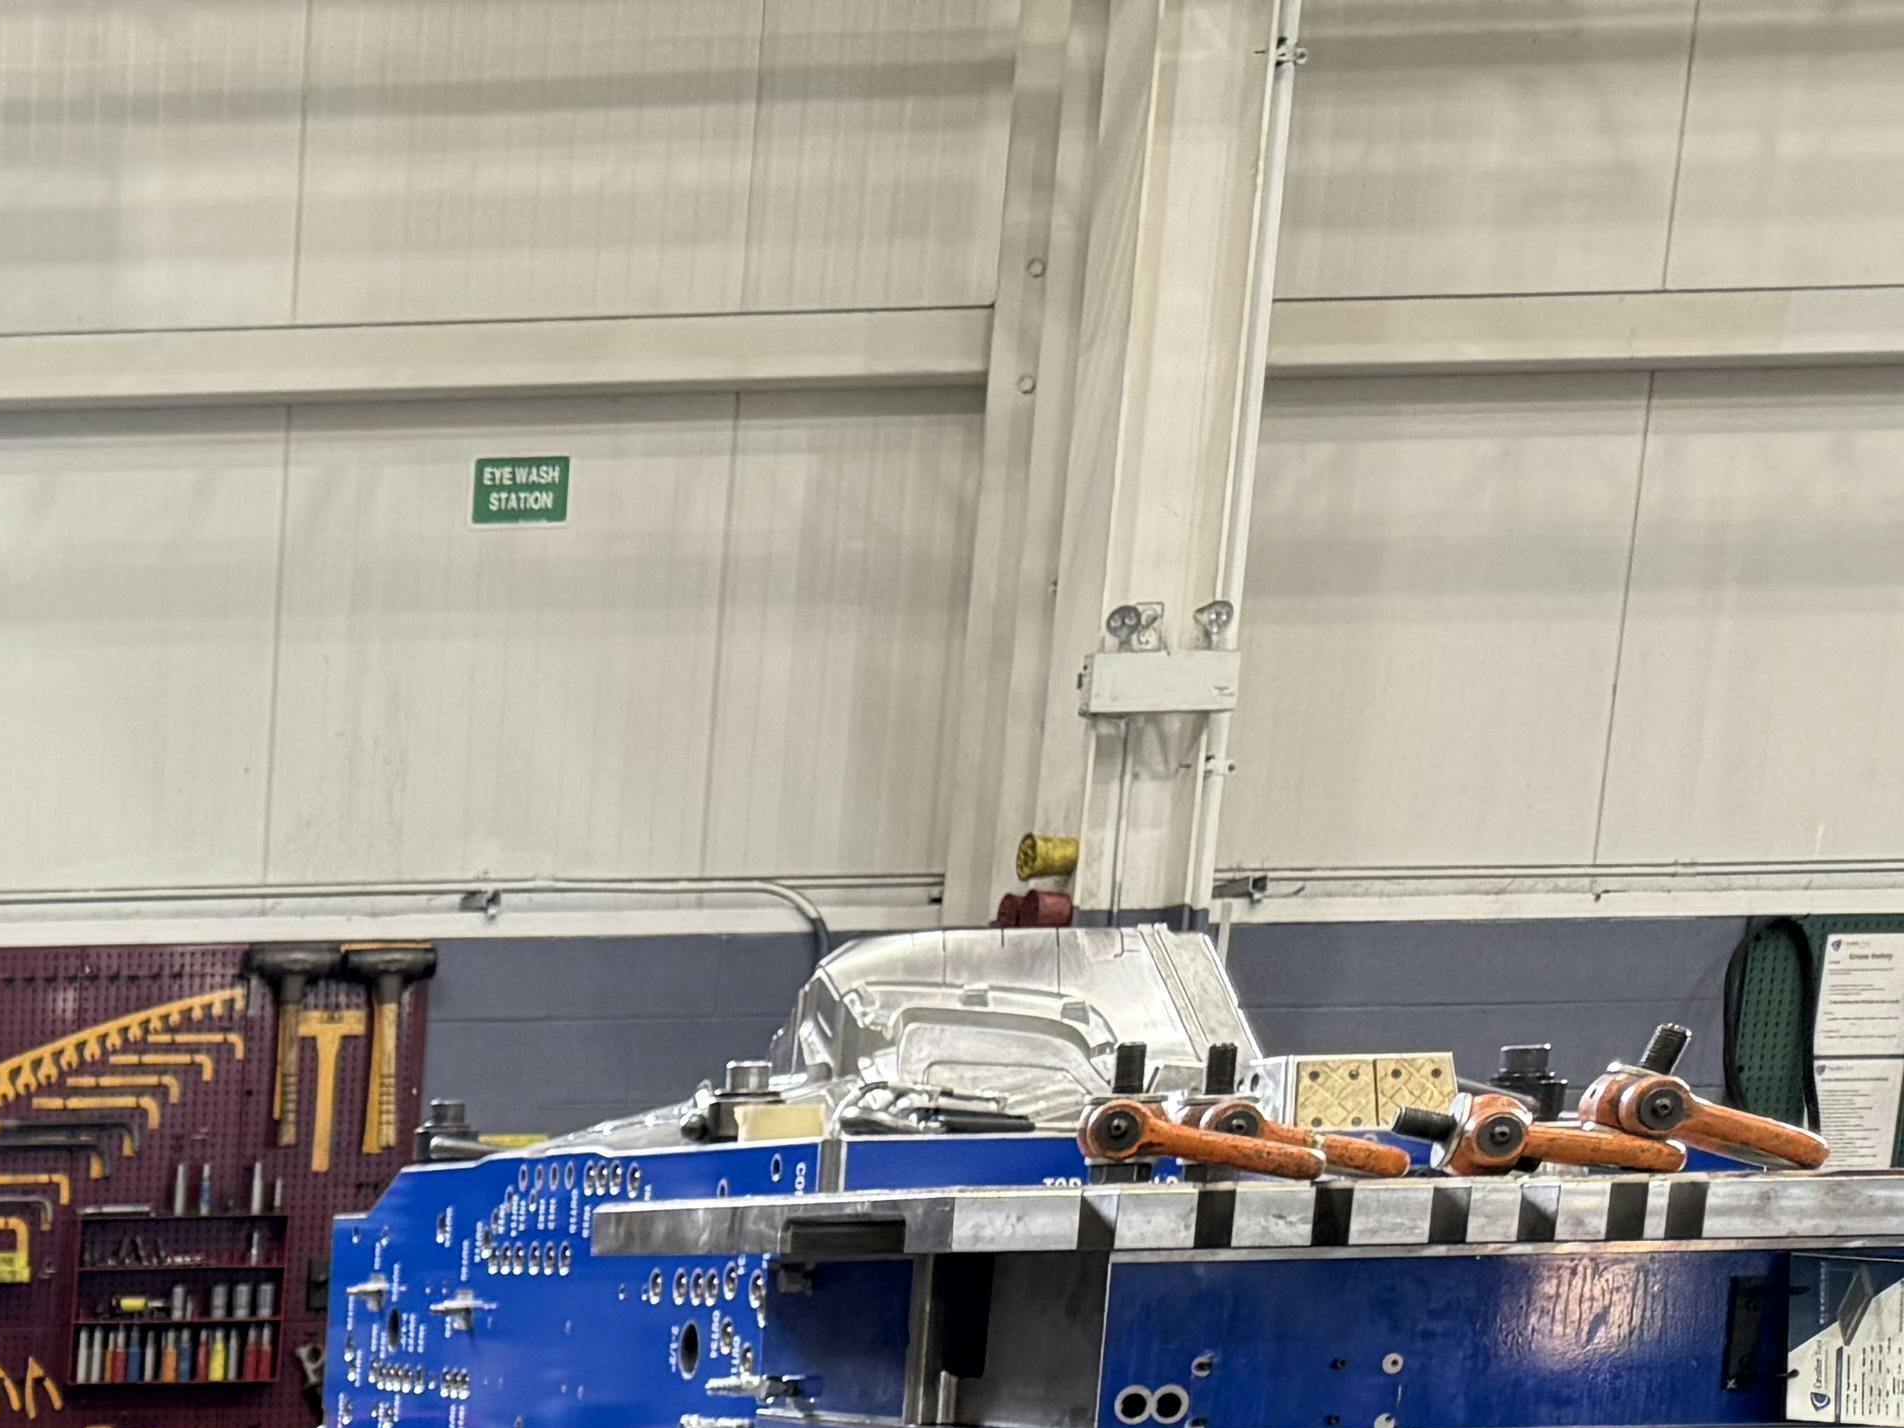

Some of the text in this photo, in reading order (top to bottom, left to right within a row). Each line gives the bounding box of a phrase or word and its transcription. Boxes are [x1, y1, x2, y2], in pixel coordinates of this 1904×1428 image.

[483, 465, 560, 485] EYE WASH
[488, 491, 554, 510] STATION
